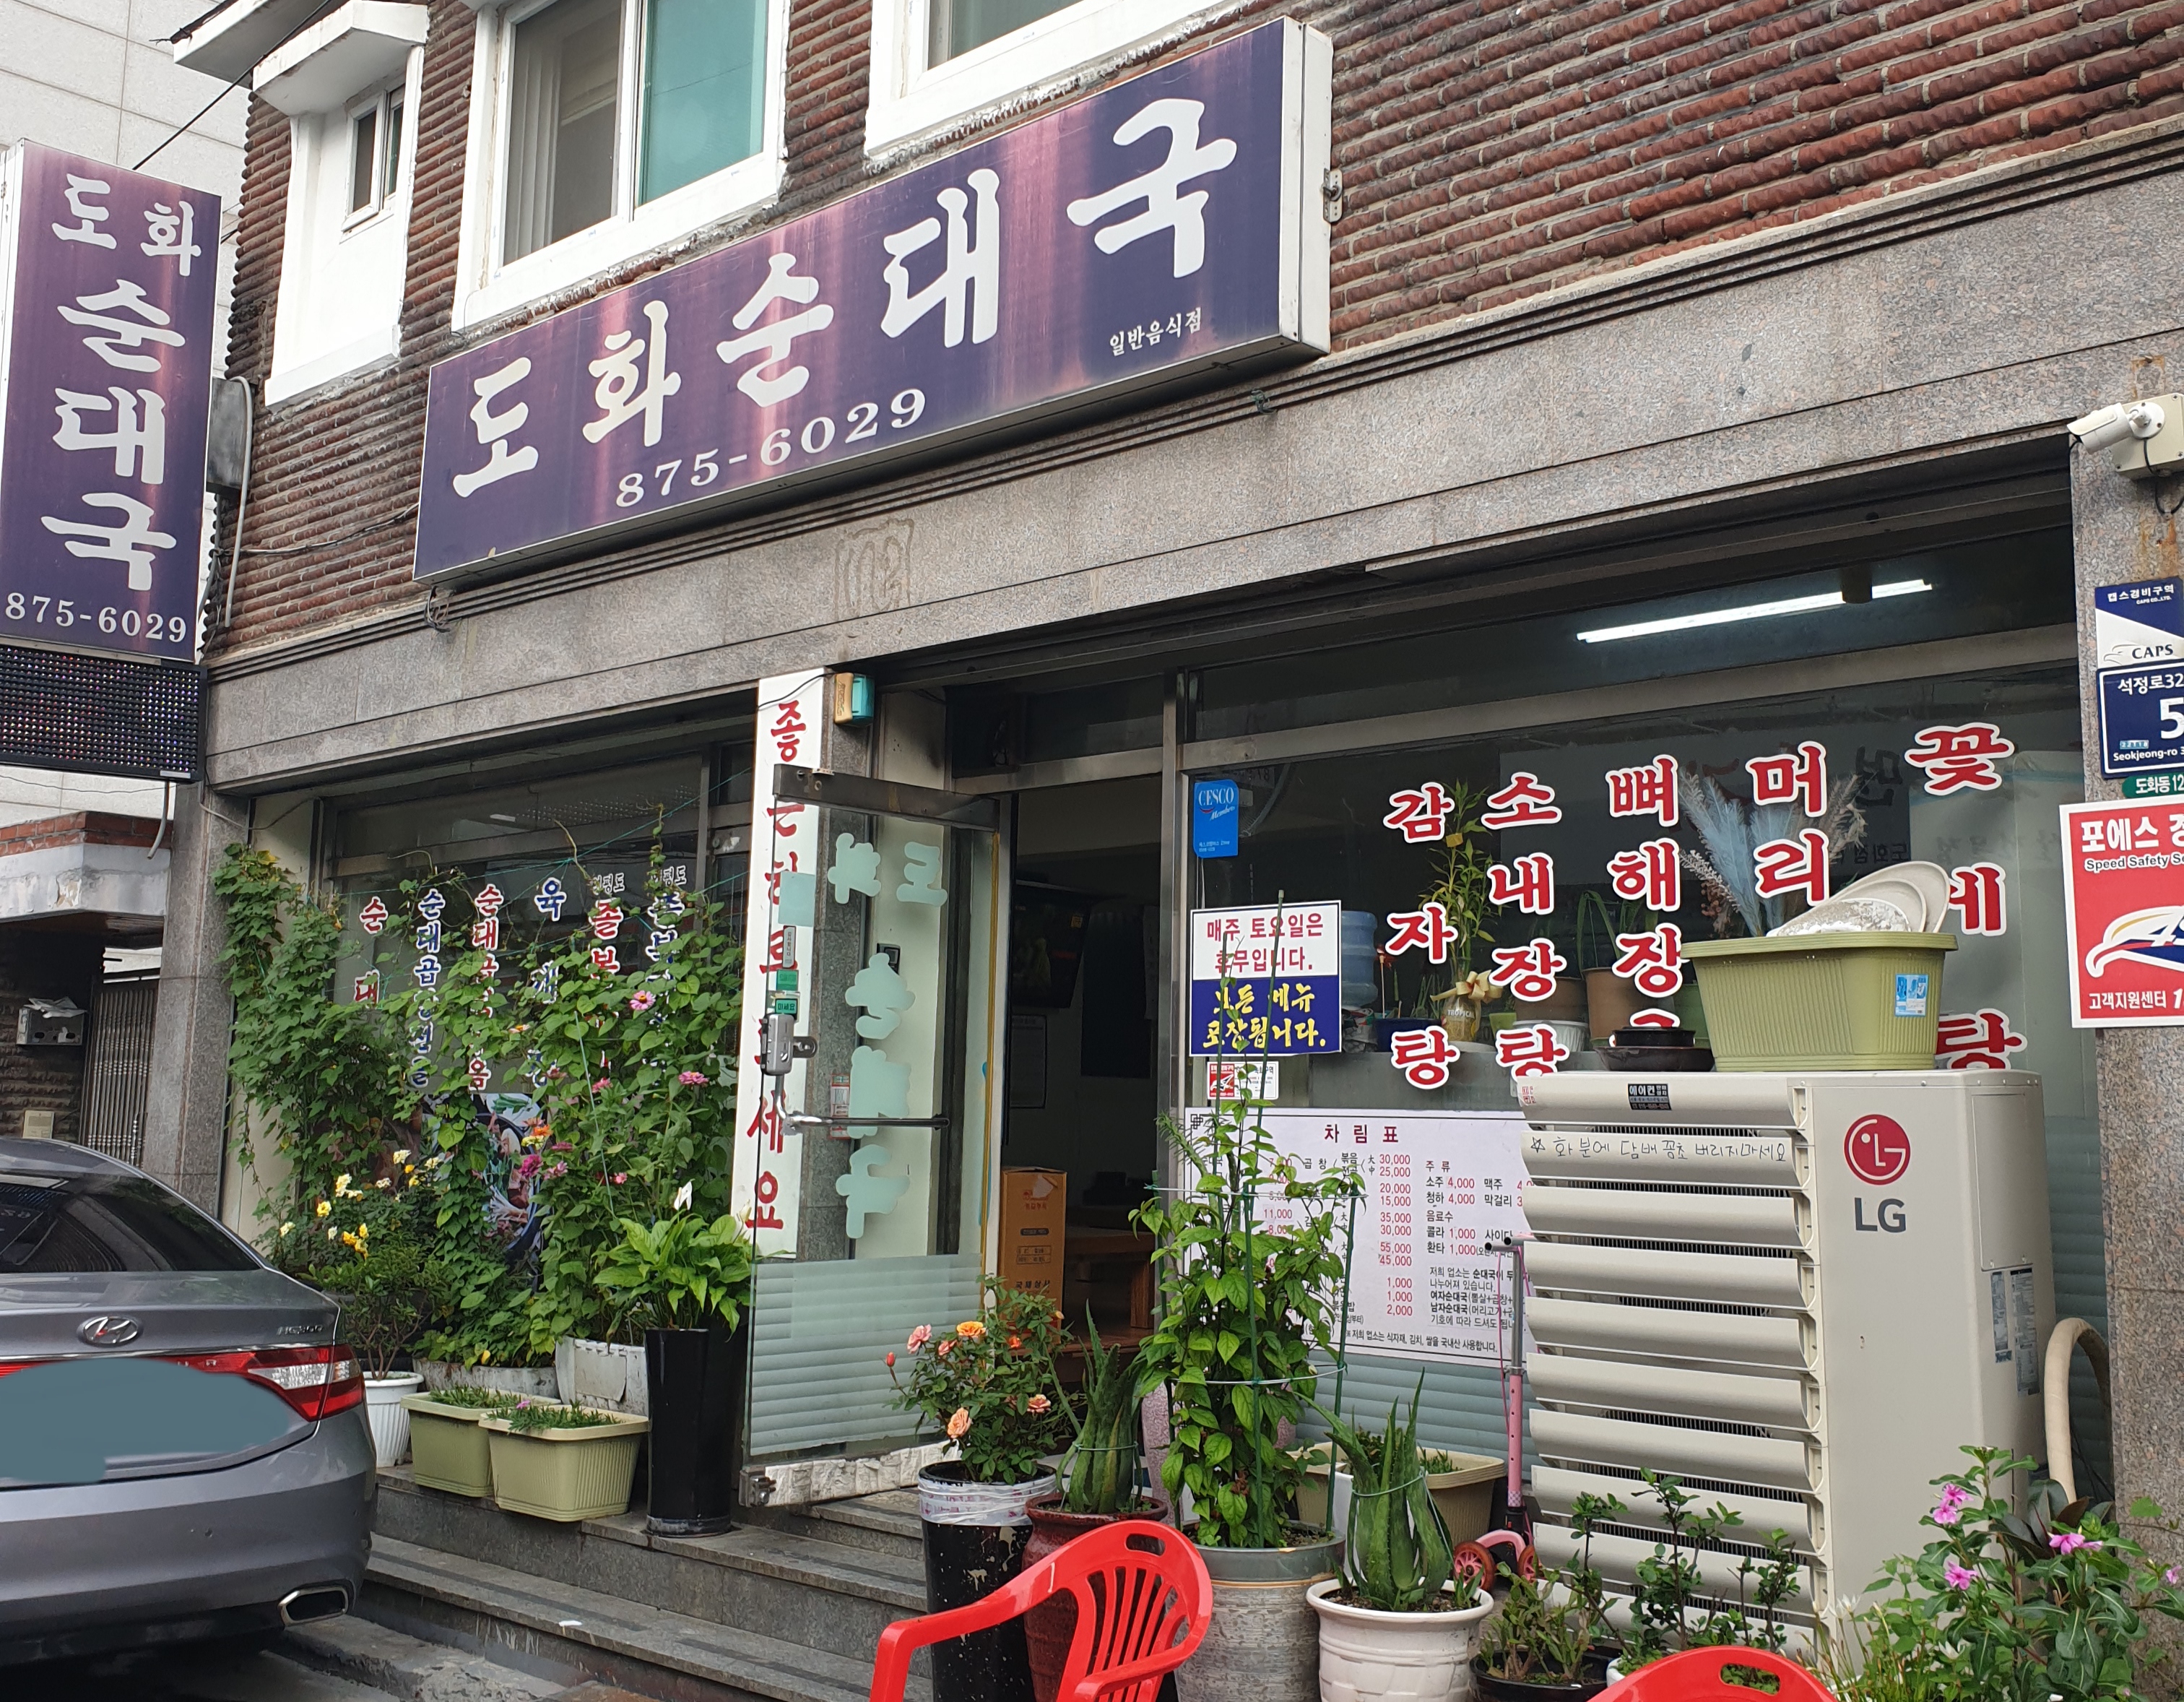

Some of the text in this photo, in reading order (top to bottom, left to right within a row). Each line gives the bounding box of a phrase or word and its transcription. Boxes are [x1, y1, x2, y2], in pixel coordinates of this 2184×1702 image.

[1109, 306, 1202, 357] 일반음식점
[40, 279, 186, 591] 순대국
[615, 387, 927, 508] 875-6029
[4, 592, 187, 644] 875-6029
[2131, 644, 2174, 659] CAPS
[2113, 748, 2178, 761] Seokjeong-ro
[2136, 775, 2170, 794] 도화동
[1199, 787, 1234, 807] CESCO
[2081, 816, 2159, 852] 포에스
[2086, 857, 2126, 872] Speed
[2129, 854, 2168, 868] Safety
[1207, 912, 1323, 941] 매주 토요일은
[1481, 771, 1569, 1078] 소내장탕
[1383, 782, 1460, 1090] 감자탕
[1215, 946, 1313, 974] 휴무입니다.
[2089, 990, 2167, 1010] 고객지원센터
[1379, 1154, 1410, 1165] 30,000
[1379, 1167, 1410, 1178] 25,000
[1379, 1183, 1411, 1195] 20,000
[1426, 1176, 1444, 1188] 소주
[1447, 1177, 1475, 1189] 4,000
[1484, 1178, 1503, 1191] 맥주
[1380, 1196, 1411, 1208] 15,000
[1426, 1192, 1444, 1204] 청하
[1448, 1193, 1476, 1206] 4,000
[1484, 1194, 1512, 1208] 막걸리
[1264, 1209, 1293, 1219] 11,000
[1380, 1212, 1411, 1224] 35,000
[1426, 1210, 1454, 1223] 음료수
[1854, 1197, 1907, 1233] LG
[1380, 1224, 1412, 1237] 30,000
[1426, 1225, 1445, 1238] 콜라
[1449, 1228, 1476, 1240] 1,000
[1380, 1242, 1412, 1254] 55,000
[1426, 1241, 1445, 1254] 환타
[1450, 1243, 1476, 1256] 1,000
[1379, 1256, 1412, 1267] 45,000
[1429, 1266, 1444, 1276] 저희
[1447, 1267, 1470, 1279] 업소는
[1387, 1277, 1413, 1290] 1,000
[1430, 1279, 1496, 1292] 나누어져 있습니다.
[1387, 1291, 1413, 1303] 1,000
[1387, 1305, 1413, 1316] 2,000
[1431, 1315, 1453, 1326] 기호에
[1456, 1316, 1471, 1328] 따라
[1474, 1318, 1498, 1329] 드셔도
[1351, 1329, 1364, 1340] 저희
[1366, 1331, 1385, 1342] 업소는
[1387, 1332, 1407, 1344] 식자재,
[1409, 1334, 1424, 1347] 김치,
[1441, 1336, 1460, 1349] 국내산
[1462, 1339, 1498, 1353] 사용합니다.
